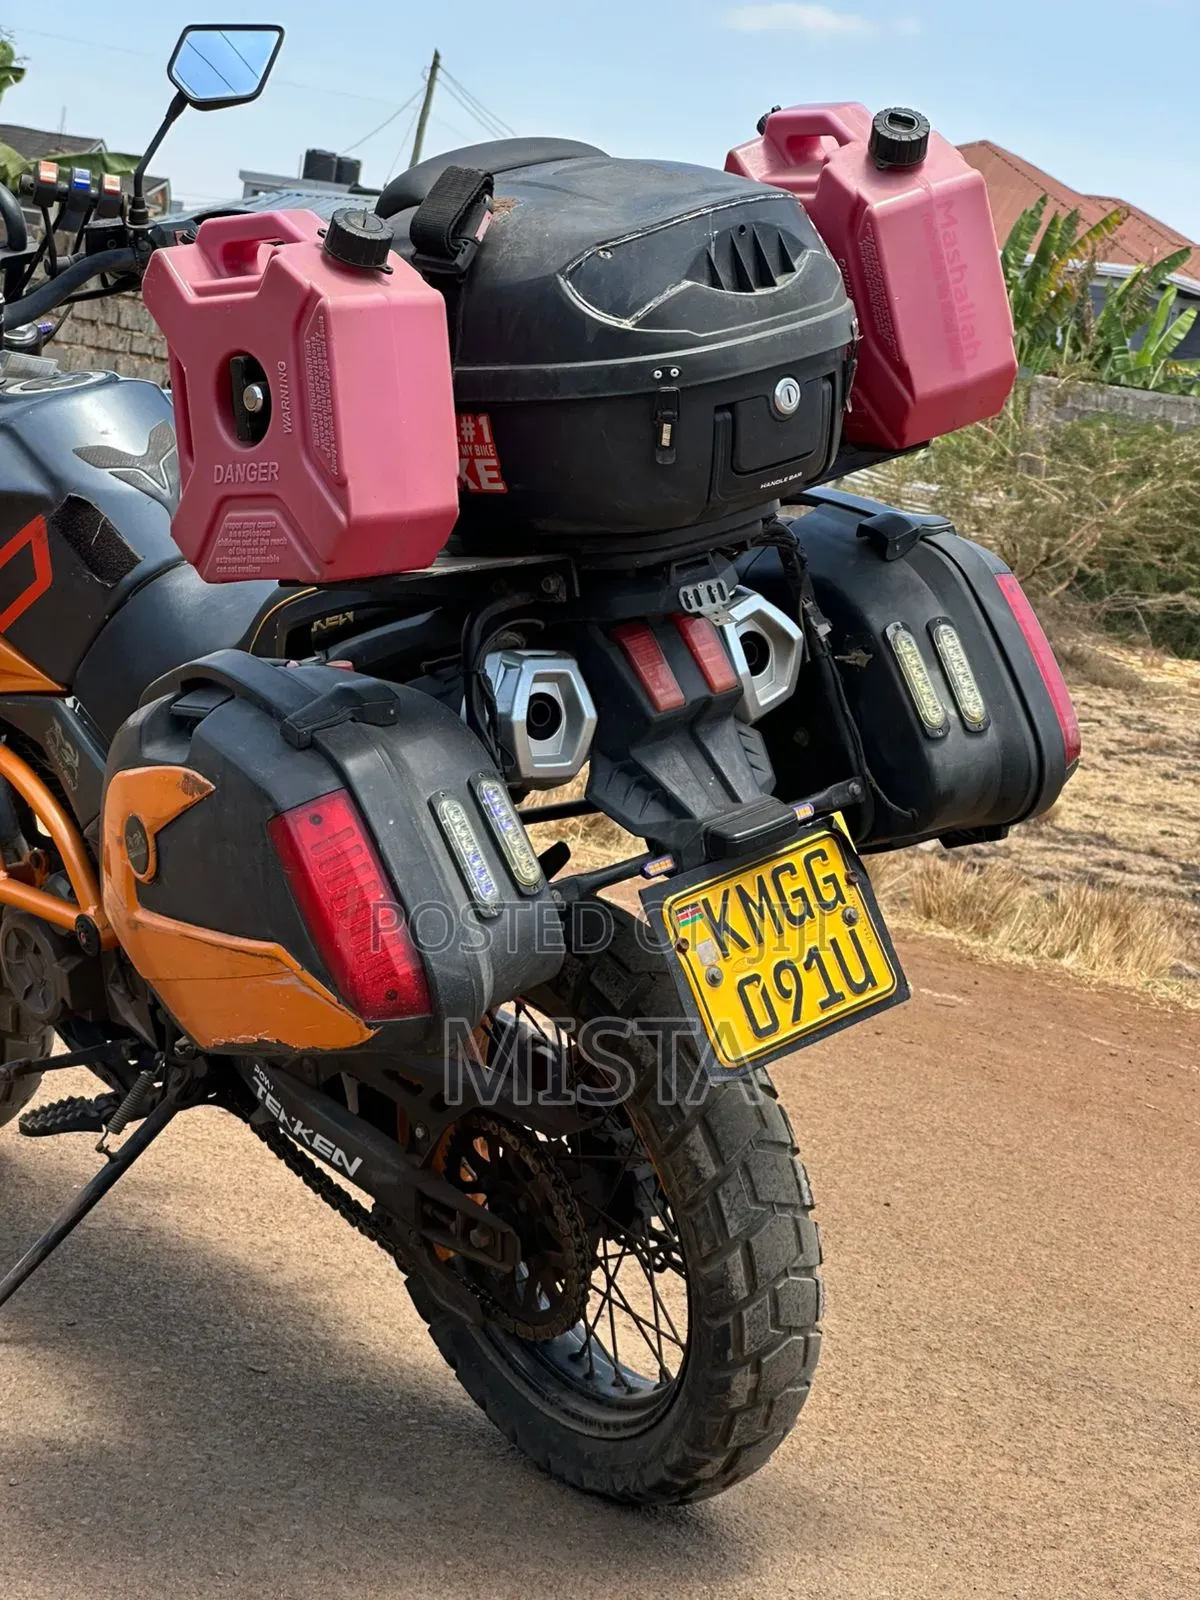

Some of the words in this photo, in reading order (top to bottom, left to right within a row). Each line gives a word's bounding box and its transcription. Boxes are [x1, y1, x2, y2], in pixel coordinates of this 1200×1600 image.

[937, 200, 982, 362] Mashallah
[277, 361, 293, 434] WARNING
[461, 415, 491, 443] #1
[213, 461, 279, 484] DANGER
[461, 444, 473, 456] MY
[474, 444, 495, 456] BIKE
[788, 471, 803, 481] BAR
[701, 848, 847, 960] KMGG
[736, 928, 877, 1039] 091U
[252, 1075, 363, 1177] TEKKEN
